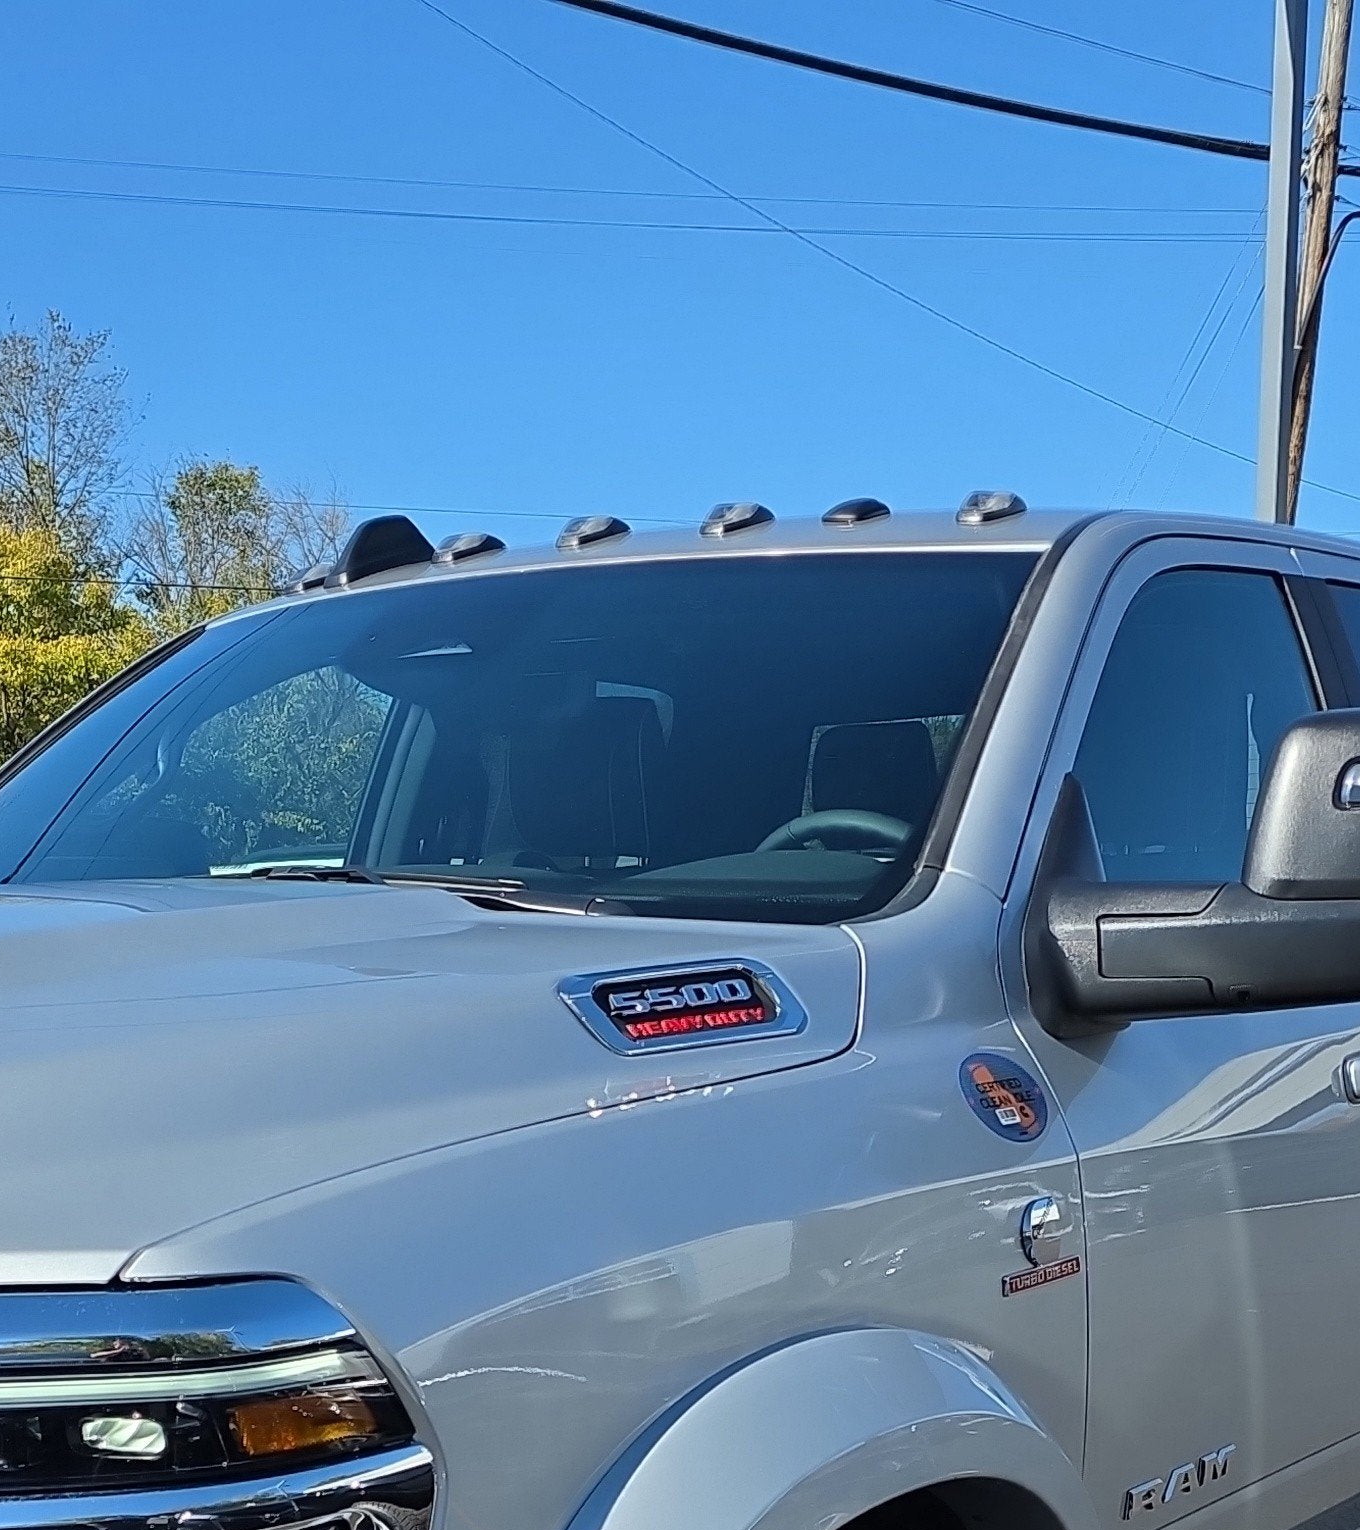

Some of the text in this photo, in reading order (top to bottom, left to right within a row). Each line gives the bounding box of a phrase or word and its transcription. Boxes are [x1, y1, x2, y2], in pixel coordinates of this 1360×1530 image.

[608, 978, 752, 1017] 5500
[625, 1006, 764, 1038] HEAVY DUTY
[975, 1077, 1022, 1093] CERTIFIED
[980, 1090, 1035, 1109] CLEAN IDLE
[1010, 1260, 1080, 1291] TURBO DIESEL
[1119, 1443, 1237, 1520] RAM
